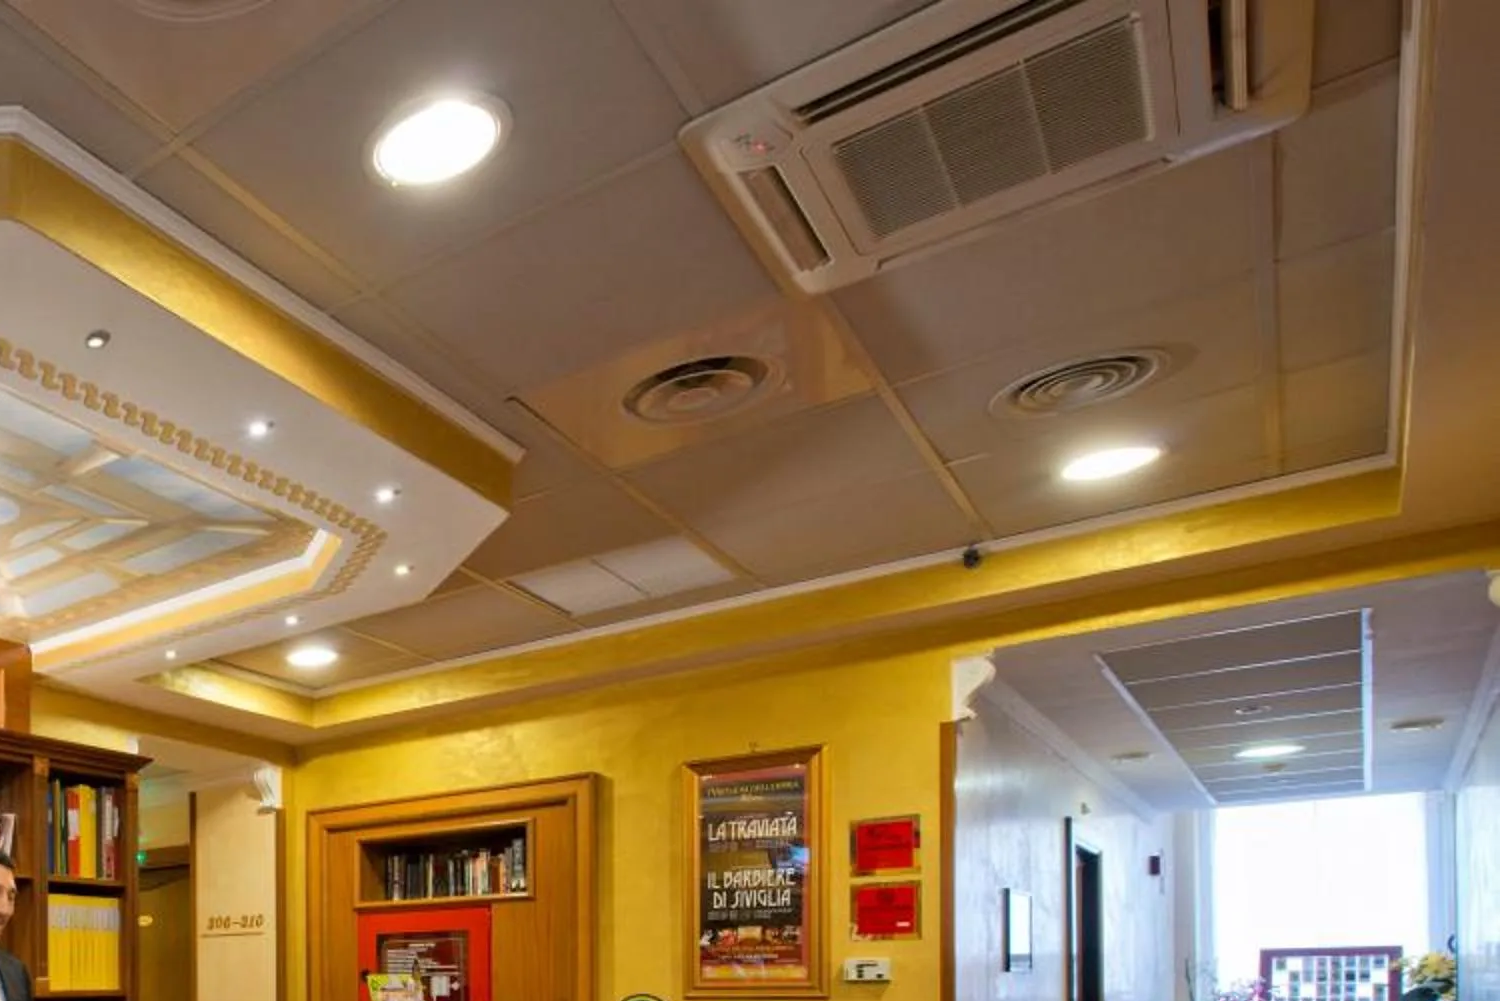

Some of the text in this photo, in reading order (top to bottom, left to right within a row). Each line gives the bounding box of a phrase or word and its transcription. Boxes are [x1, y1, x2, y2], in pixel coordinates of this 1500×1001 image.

[707, 821, 727, 842] LA
[707, 867, 797, 889] IL BARBIERE
[713, 888, 792, 909] DI SIVIGLIA
